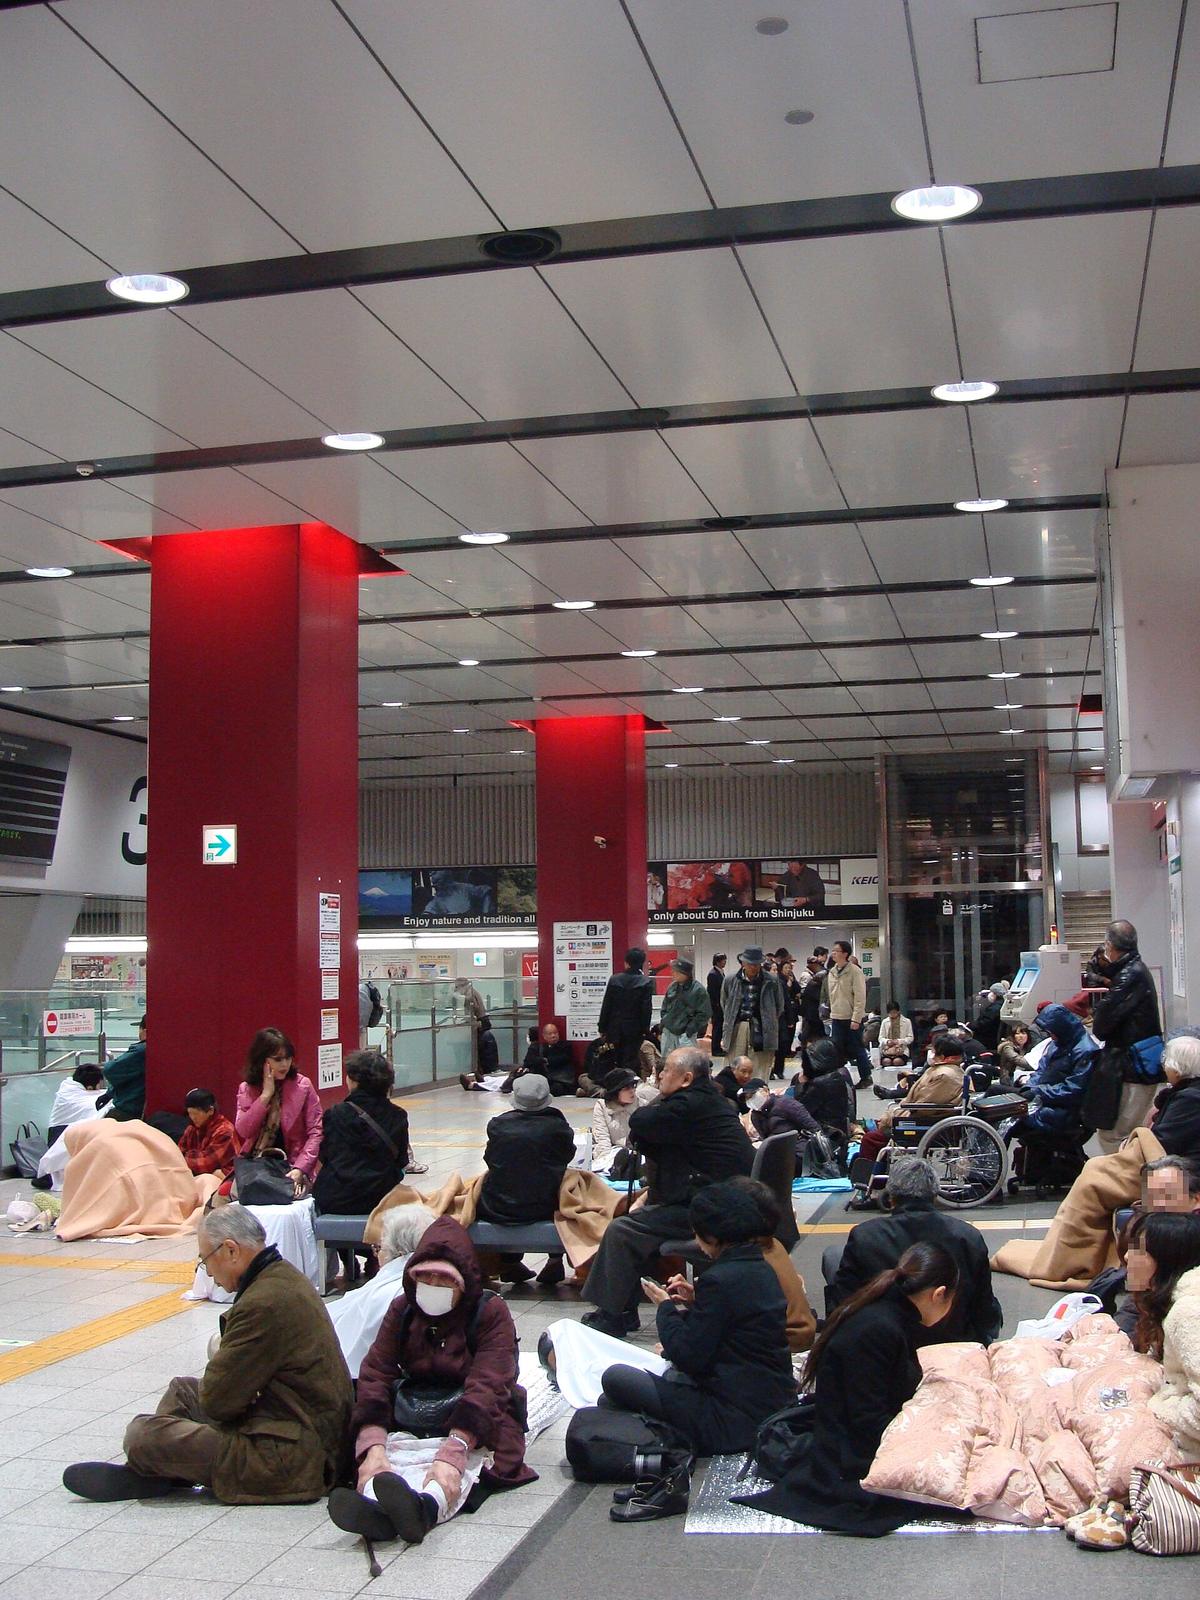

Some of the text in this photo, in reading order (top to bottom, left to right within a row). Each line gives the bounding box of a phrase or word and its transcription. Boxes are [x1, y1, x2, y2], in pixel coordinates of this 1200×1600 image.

[653, 908, 815, 922] only about 50 min. from Shinjuku
[403, 914, 536, 928] Enjoy nature and tradition all
[570, 976, 578, 985] 4
[570, 990, 578, 999] 5
